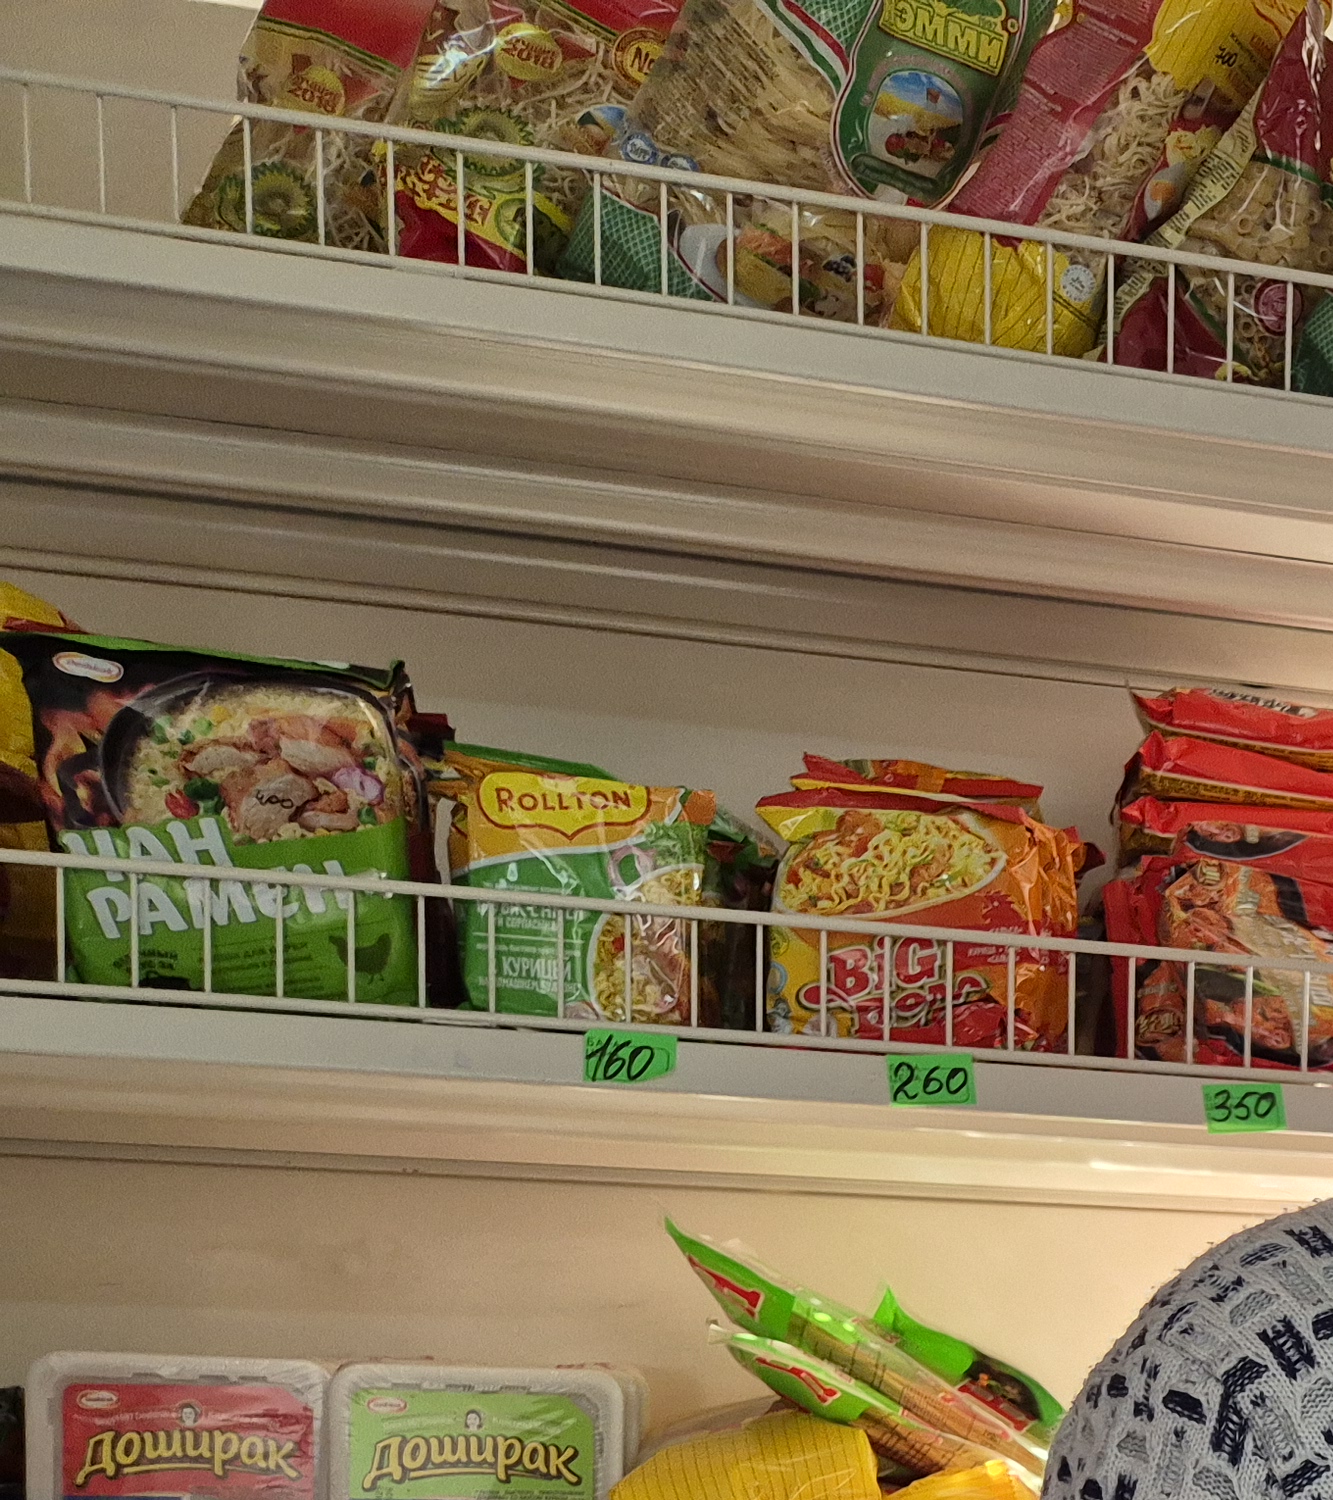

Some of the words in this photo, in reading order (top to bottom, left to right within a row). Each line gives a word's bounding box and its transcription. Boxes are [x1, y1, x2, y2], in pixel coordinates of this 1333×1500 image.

[495, 785, 632, 814] ROLLTON
[585, 1033, 656, 1082] 160
[892, 1061, 969, 1102] 260
[1209, 1089, 1278, 1124] 350
[74, 1427, 301, 1487] Доширак
[363, 1430, 582, 1488] Доширак
